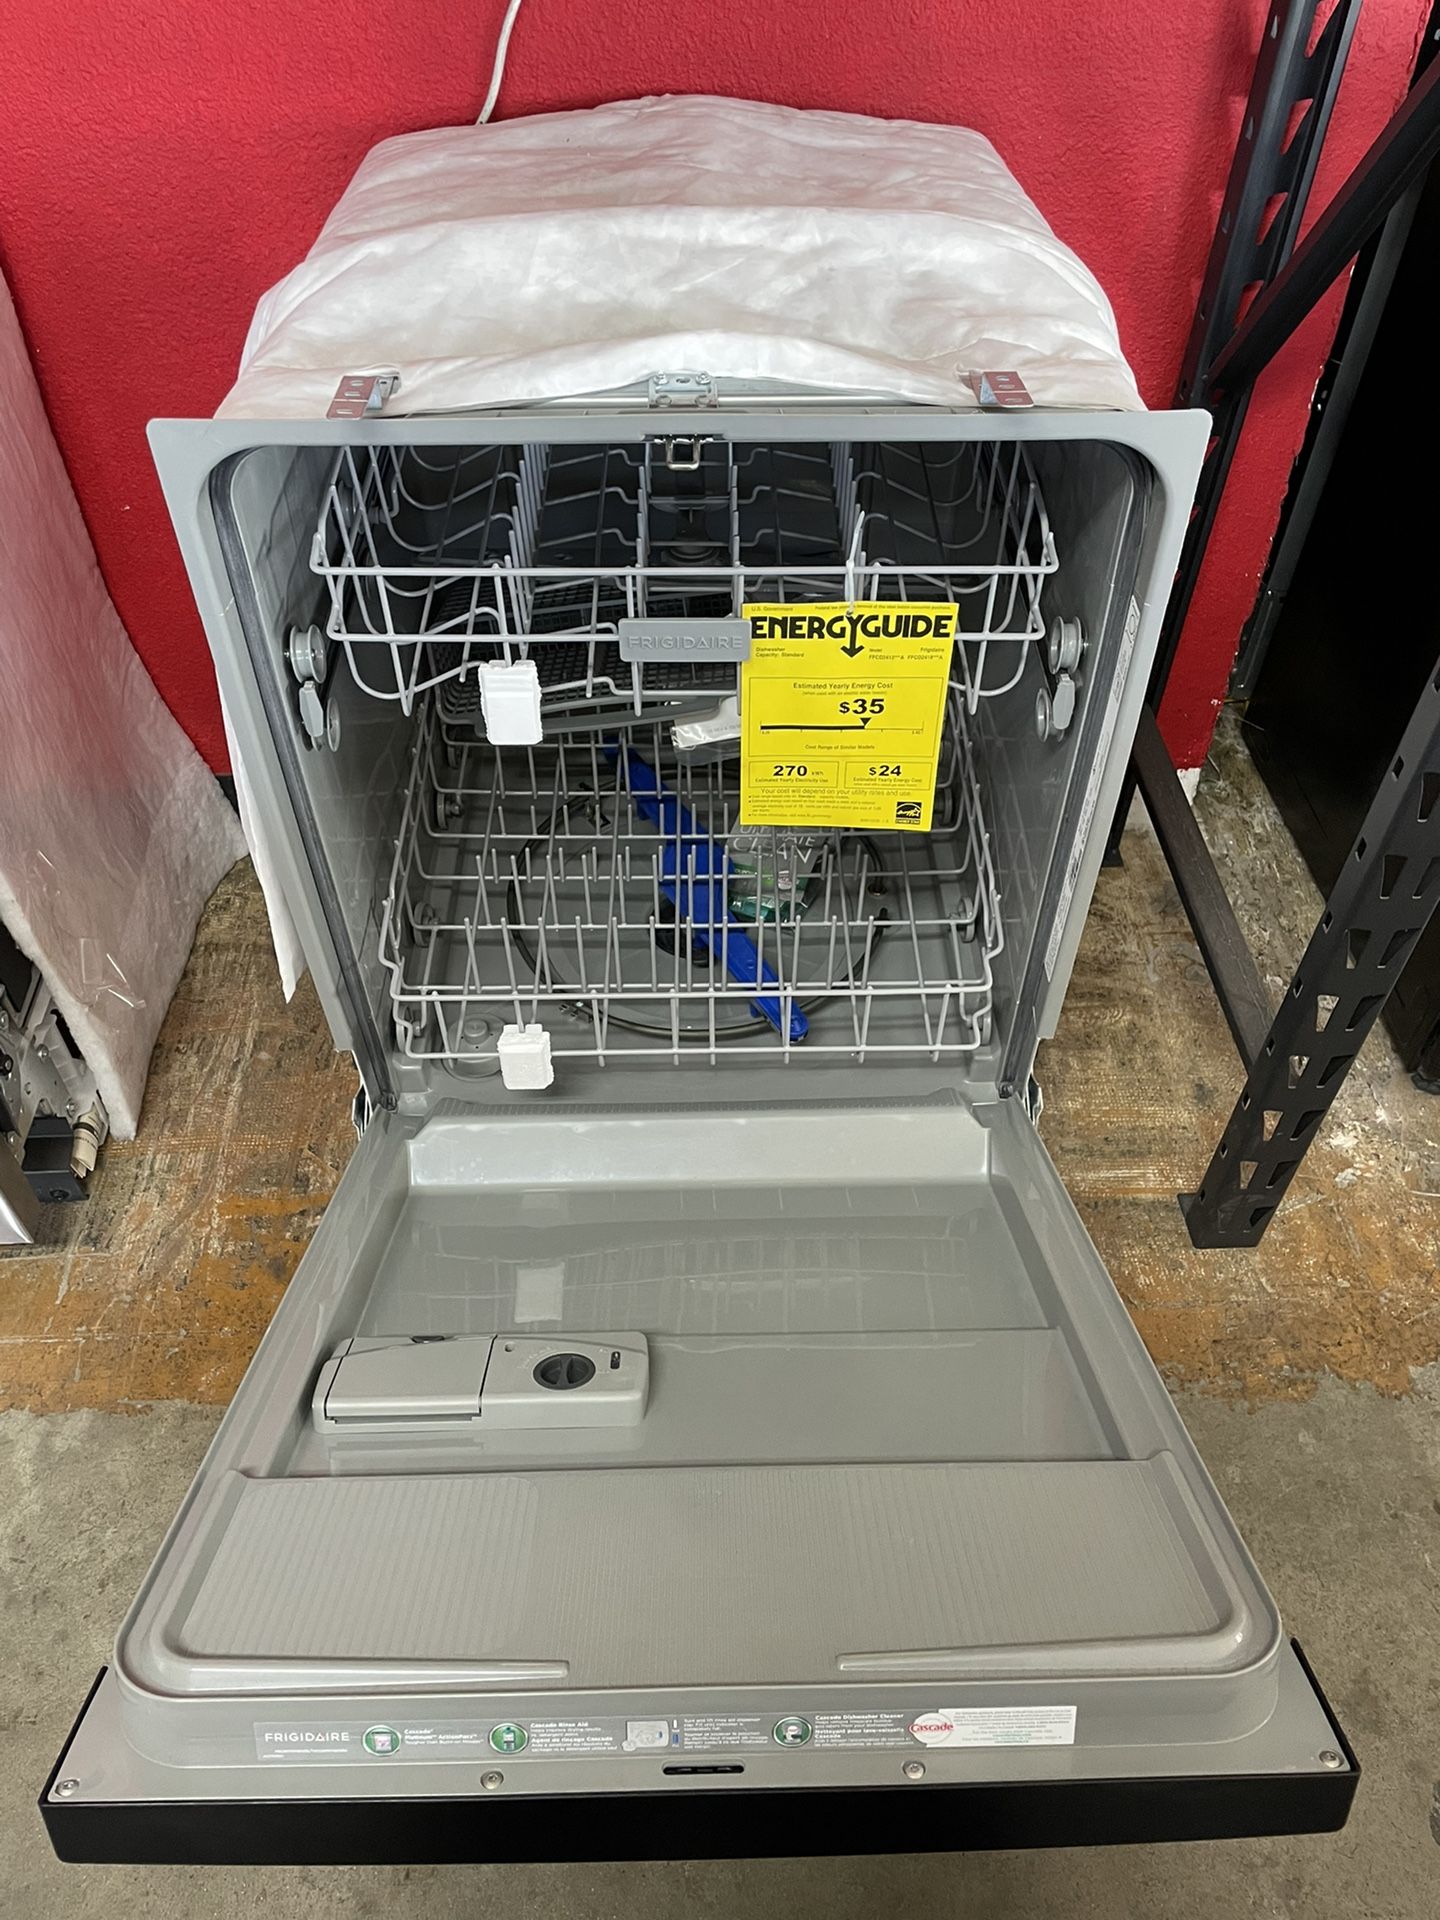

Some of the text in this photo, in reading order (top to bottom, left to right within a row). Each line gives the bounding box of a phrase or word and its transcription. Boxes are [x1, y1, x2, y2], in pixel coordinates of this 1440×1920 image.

[750, 614, 953, 653] ENERGYGUIDE
[628, 636, 743, 649] FRIGIDAIRE
[828, 682, 850, 690] Yearly
[851, 682, 875, 690] Energy
[839, 698, 885, 714] $35
[773, 765, 808, 777] 270
[869, 765, 902, 777] $24
[802, 788, 825, 796] depend
[911, 1721, 954, 1733] Cascade
[265, 1732, 350, 1742] FRIGIDAIRE
